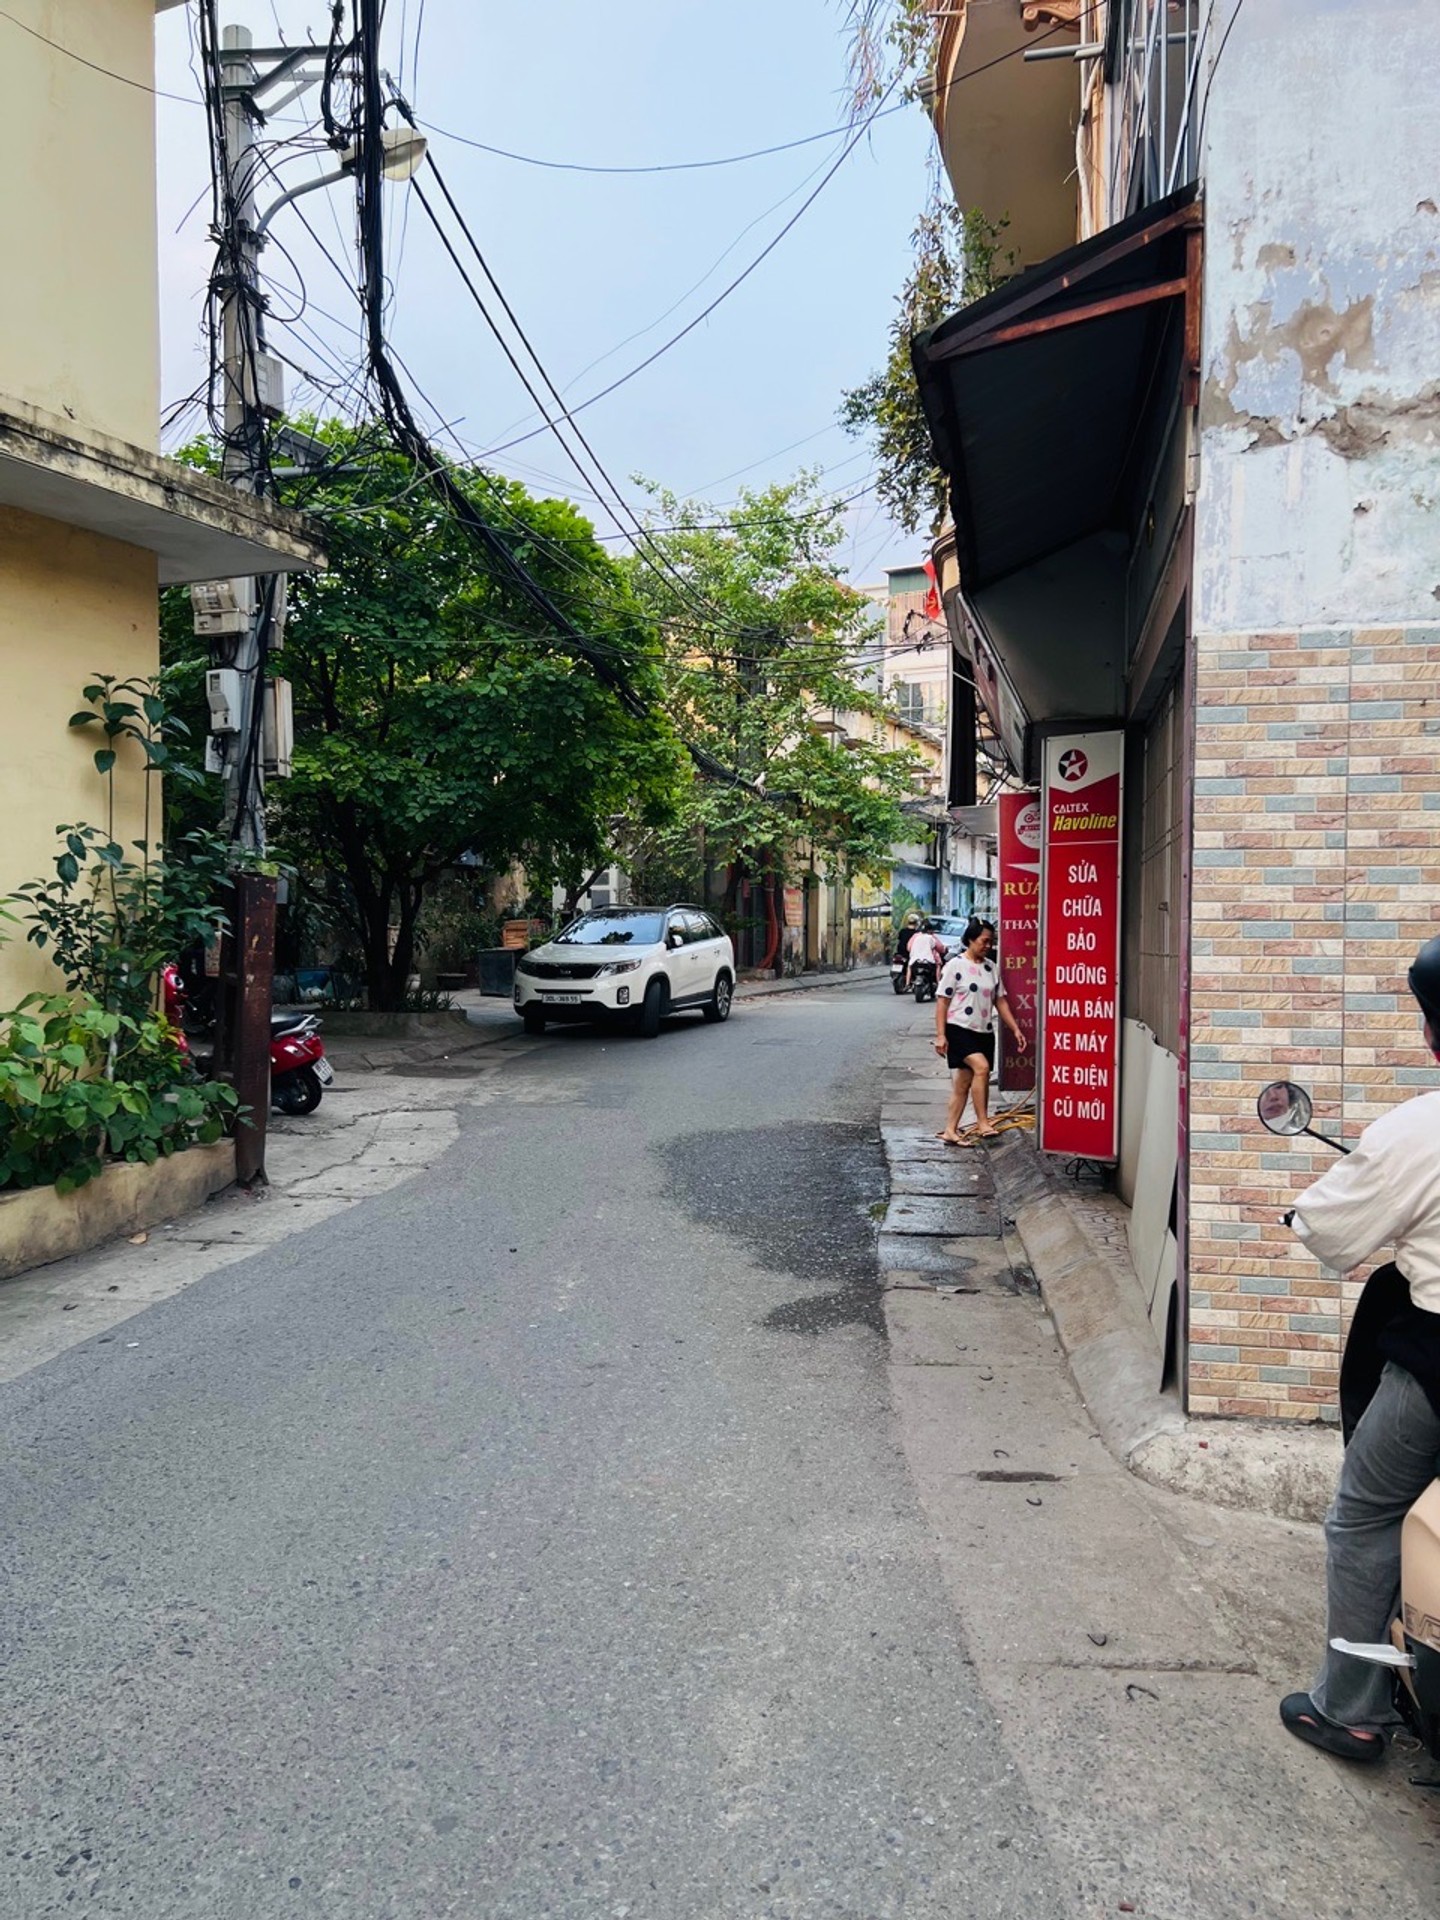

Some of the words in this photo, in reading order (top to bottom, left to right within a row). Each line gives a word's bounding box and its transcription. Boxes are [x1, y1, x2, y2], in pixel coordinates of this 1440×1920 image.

[1053, 803, 1089, 814] CALTEX
[1053, 813, 1117, 831] Havoline
[1068, 859, 1098, 883] SỬA
[1062, 895, 1102, 917] CHỮA
[1067, 928, 1097, 951] BẢO
[1055, 963, 1107, 985] DƯỠNG
[1048, 999, 1079, 1017] MUA
[1084, 997, 1114, 1019] BÁN
[1053, 1032, 1071, 1050] XE
[1075, 1031, 1108, 1053] MÁY
[1052, 1065, 1069, 1084] XE
[1073, 1064, 1108, 1090] ĐIỆN
[1053, 1096, 1073, 1118] CŨ
[1077, 1097, 1106, 1121] MỚI
